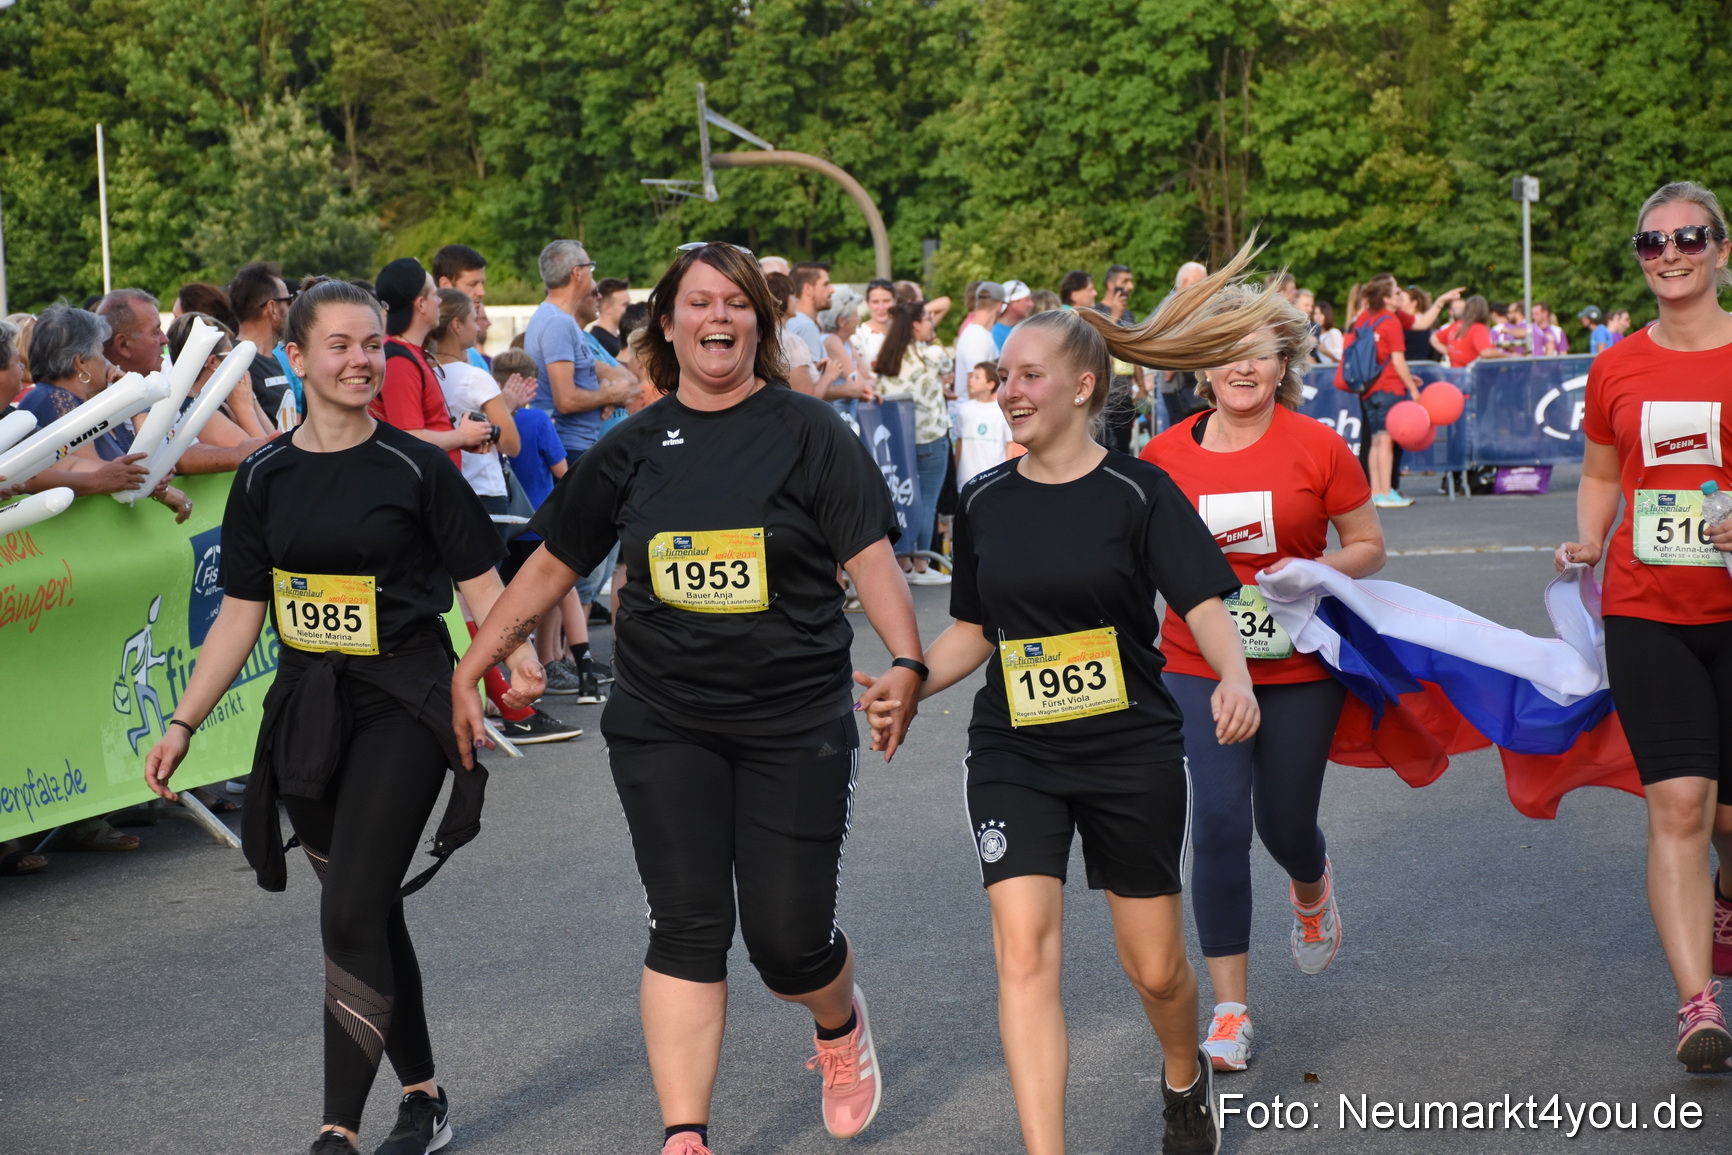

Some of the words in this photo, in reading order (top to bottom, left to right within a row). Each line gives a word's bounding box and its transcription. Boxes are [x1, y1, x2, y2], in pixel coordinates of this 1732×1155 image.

[662, 438, 684, 446] erima
[1669, 439, 1694, 450] DEHN
[1650, 504, 1692, 513] firmenlauf
[1226, 529, 1249, 543] DEHN
[665, 546, 710, 557] firmenlauf
[715, 550, 735, 559] walk
[665, 560, 750, 590] 1953
[0, 558, 74, 633] änger!
[286, 586, 324, 598] firmenlauf
[686, 591, 711, 599] Bauer
[713, 591, 733, 600] Anja
[286, 600, 362, 633] 1985
[297, 629, 324, 640] Niebler
[325, 632, 352, 641] Marina
[1249, 638, 1268, 646] Petra
[1018, 652, 1061, 664] firmenlauf
[1089, 650, 1111, 660] 2019
[1019, 661, 1106, 700] 1963
[1016, 710, 1037, 718] Regens
[1038, 708, 1060, 716] Wagner
[1061, 704, 1084, 712] Stiftung
[1085, 697, 1120, 708] Lauterhofen
[1042, 697, 1066, 708] Fürst
[1067, 695, 1090, 705] Viola
[0, 758, 87, 823] erpfalz.de
